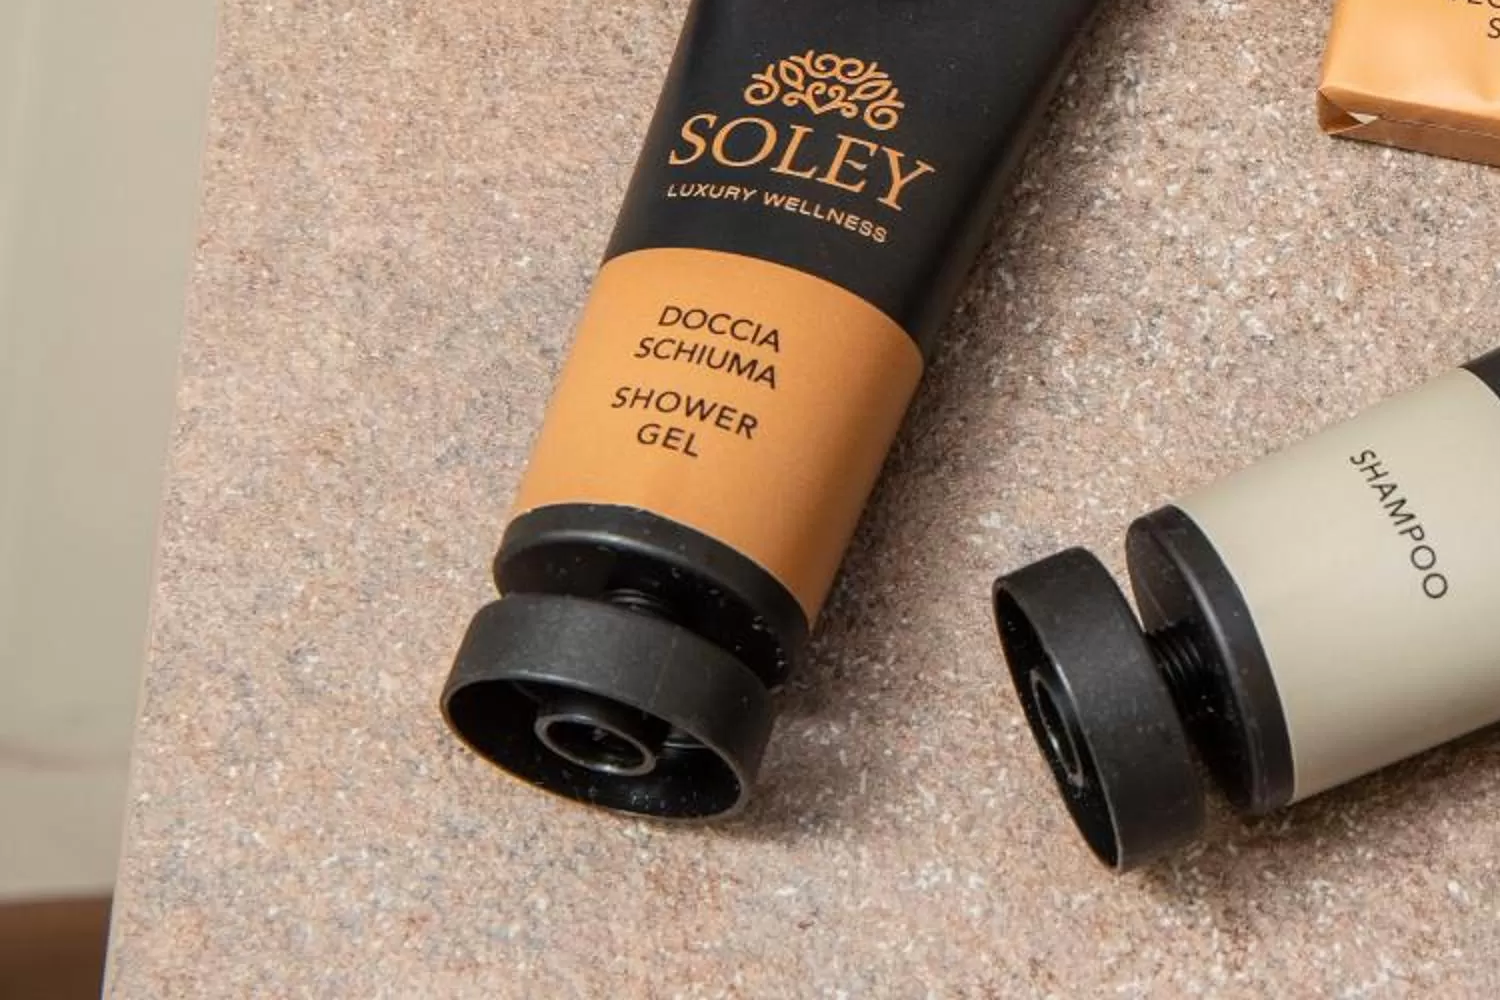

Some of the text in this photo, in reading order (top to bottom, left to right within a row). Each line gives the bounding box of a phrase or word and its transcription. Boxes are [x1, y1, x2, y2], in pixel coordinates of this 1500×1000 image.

[668, 112, 936, 211] SOLEY
[667, 182, 890, 244] LUXURY WELLNESS
[658, 305, 780, 352] DOCCIA
[634, 337, 776, 390] SCHIUMA
[611, 386, 759, 440] SHOWER
[637, 423, 700, 458] GEL
[1349, 448, 1449, 600] SHAMPOO
